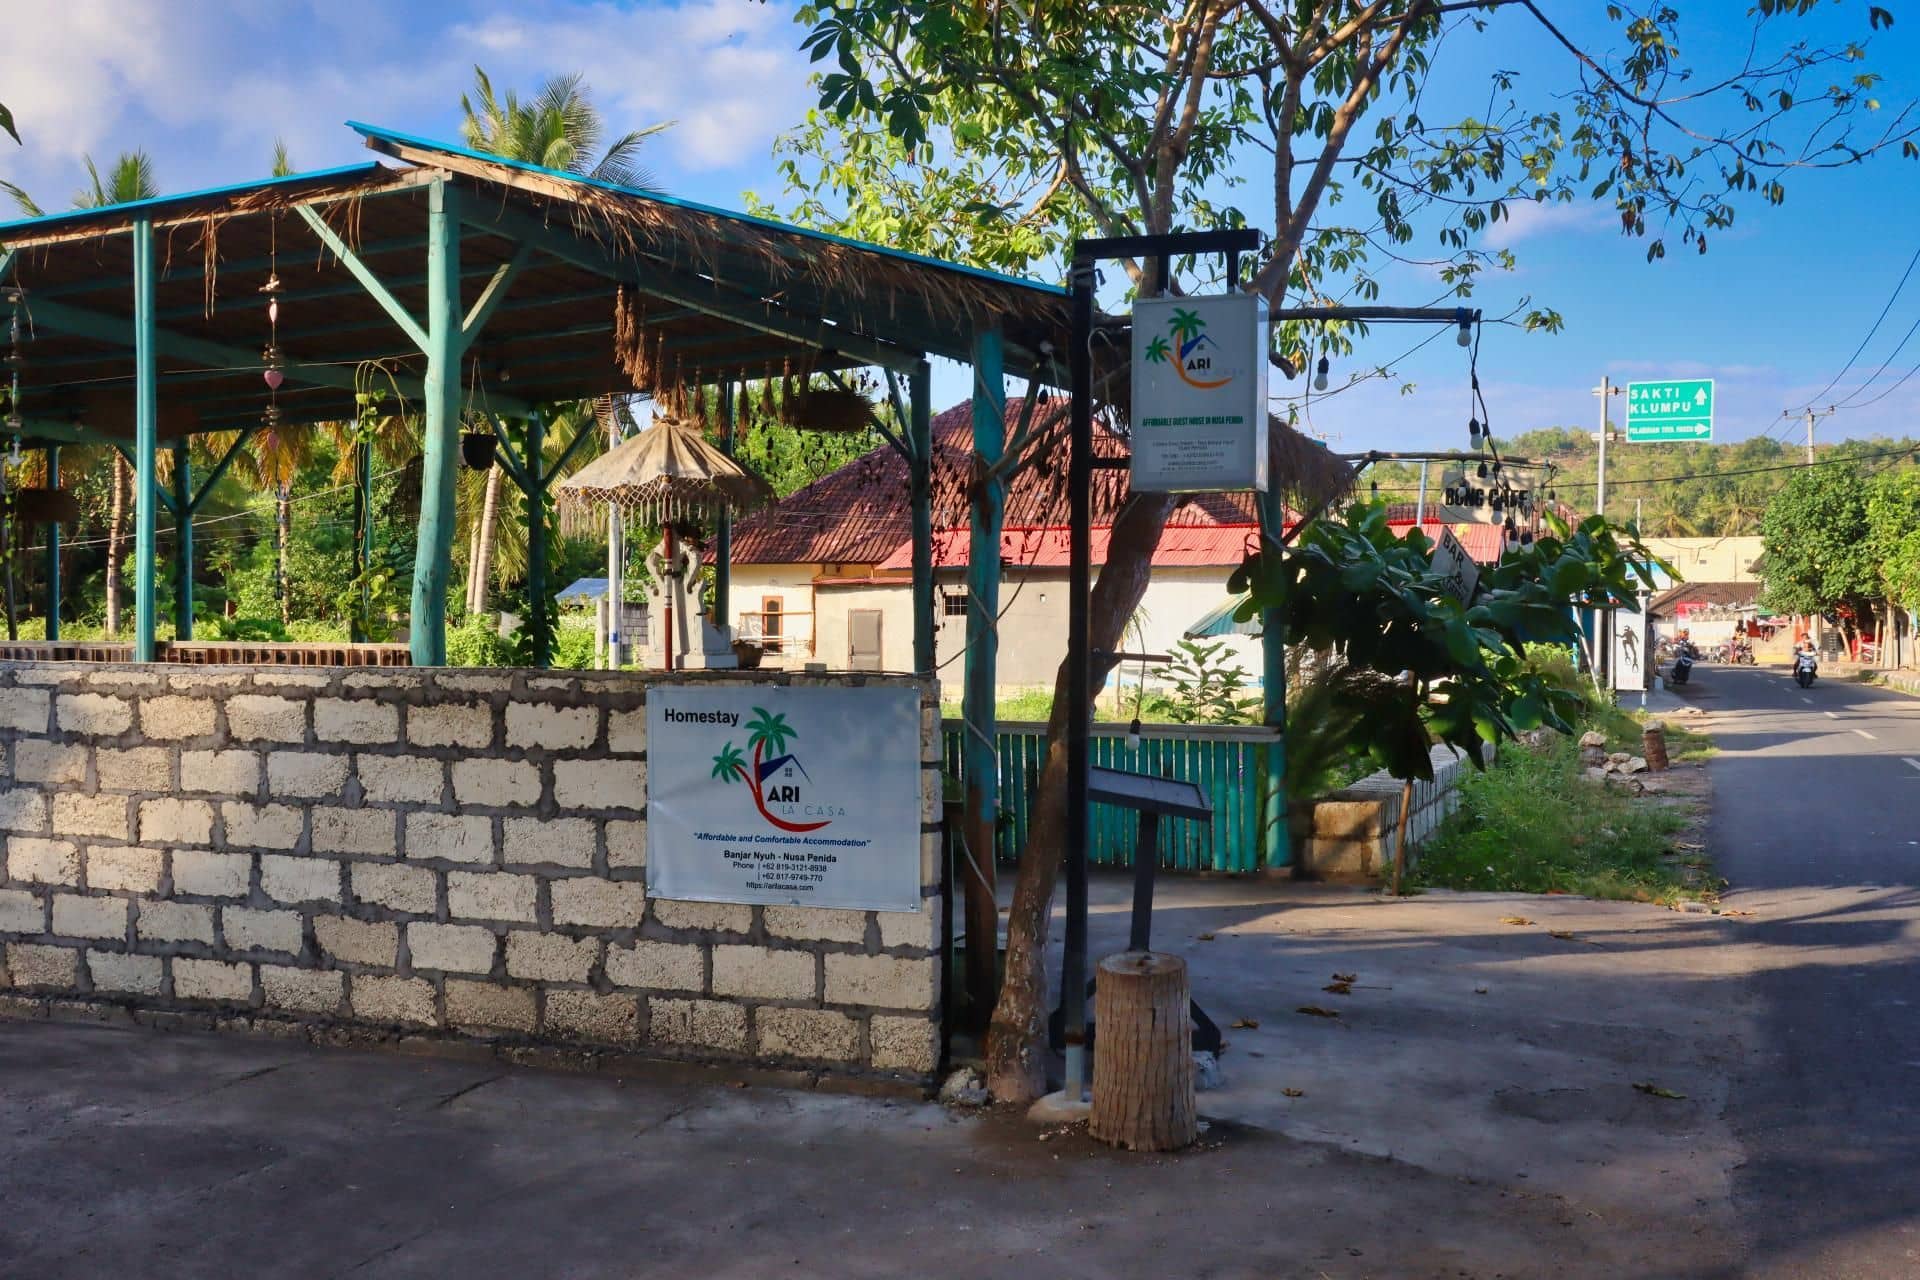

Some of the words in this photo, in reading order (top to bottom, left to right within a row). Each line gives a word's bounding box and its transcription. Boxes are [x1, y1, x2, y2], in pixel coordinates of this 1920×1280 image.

[1187, 358, 1211, 370] ARI
[1630, 387, 1680, 400] SAKTI
[1630, 401, 1691, 414] KLUMPU
[1443, 534, 1464, 568] BAR
[664, 708, 739, 727] Homestay
[767, 785, 800, 803] ARI
[782, 805, 794, 815] LA
[804, 805, 846, 817] CASA
[754, 835, 801, 844] Comfortable
[724, 850, 751, 861] Banjar
[753, 852, 776, 861] Nyuh
[783, 853, 805, 861] Nusa
[807, 853, 837, 862] Penida
[733, 861, 754, 869] Phone
